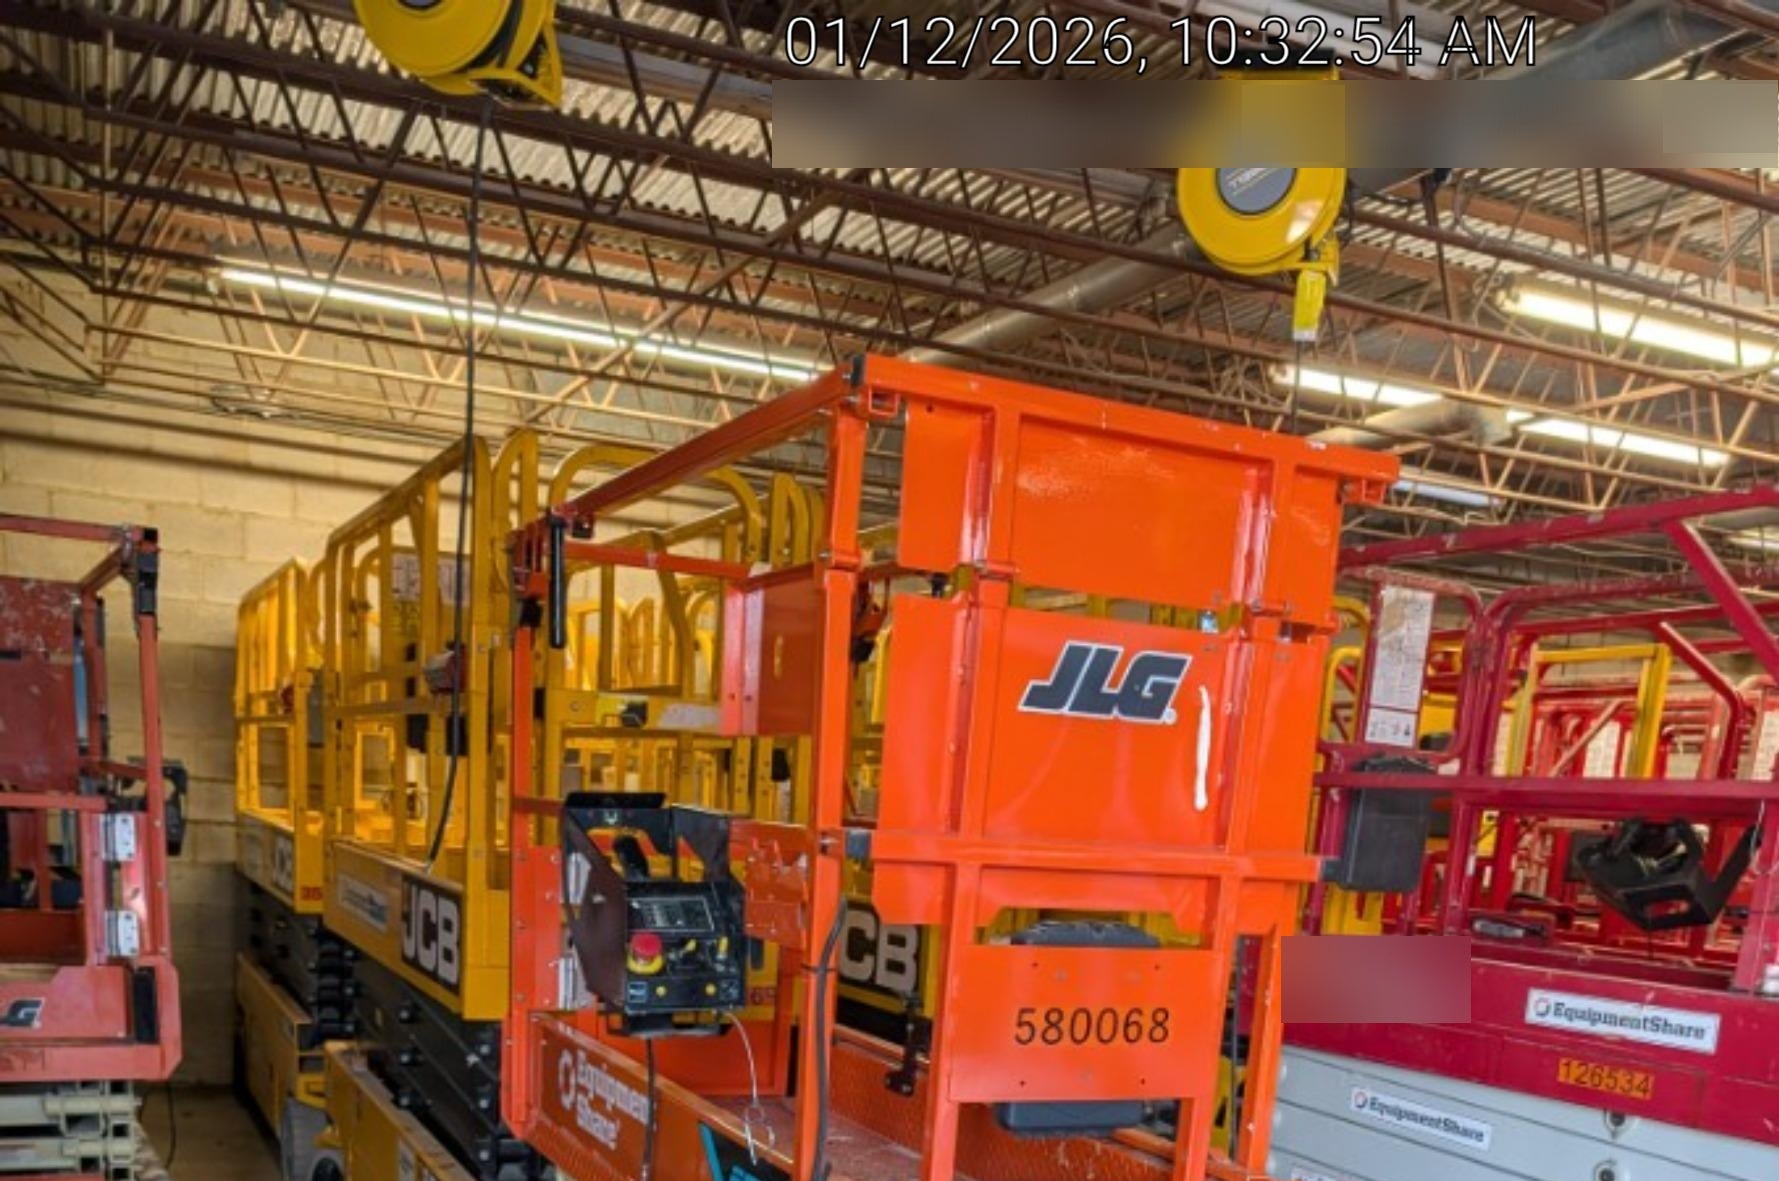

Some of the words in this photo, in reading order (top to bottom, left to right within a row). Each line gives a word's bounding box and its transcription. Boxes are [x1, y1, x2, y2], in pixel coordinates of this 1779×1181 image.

[1018, 640, 1193, 725] JLG
[403, 885, 460, 984] JCB
[839, 909, 918, 993] CB
[1014, 1007, 1170, 1046] 580068
[1553, 1001, 1706, 1040] EquipmentShare
[1561, 1060, 1650, 1096] 126534
